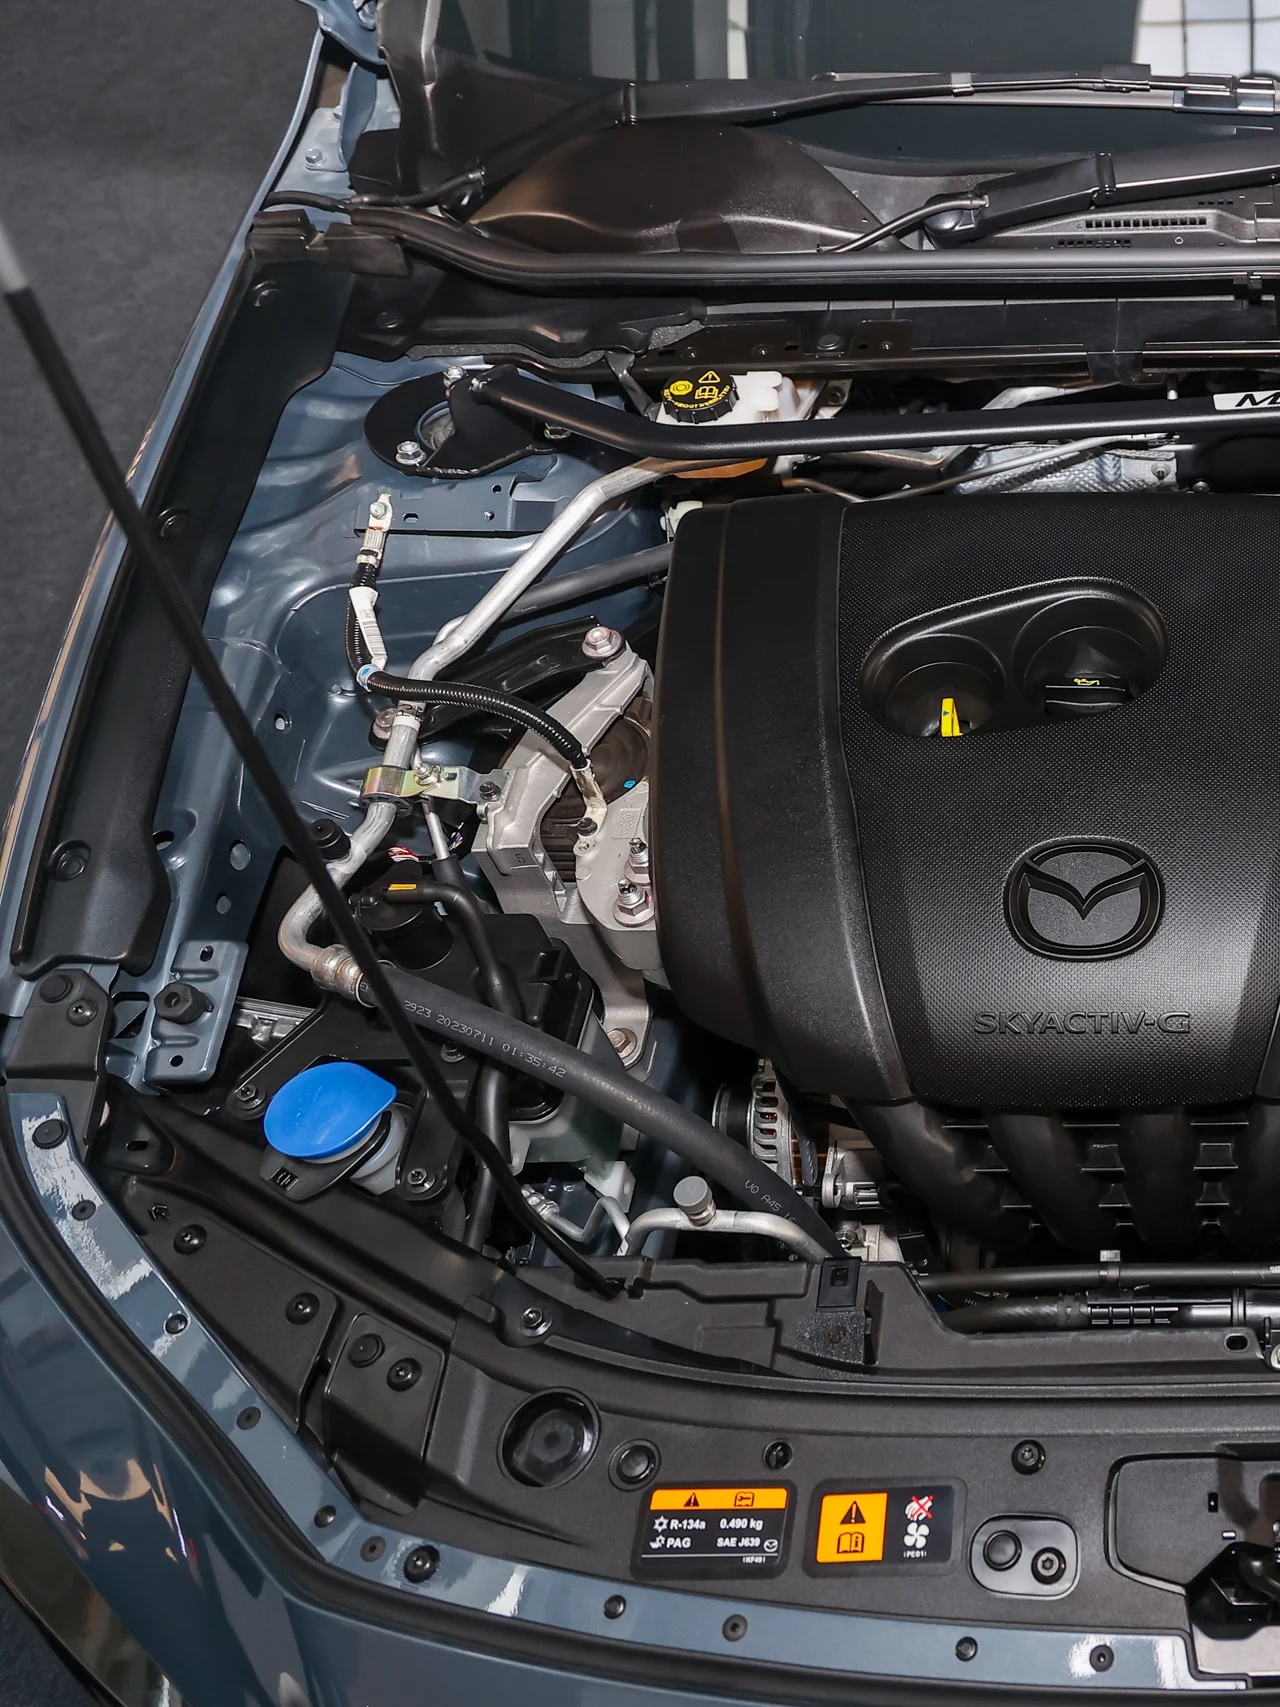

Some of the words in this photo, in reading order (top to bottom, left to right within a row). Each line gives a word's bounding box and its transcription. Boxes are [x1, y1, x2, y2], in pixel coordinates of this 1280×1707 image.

[974, 1011, 1191, 1035] SKYACTIV-G
[404, 1000, 432, 1018] 2923
[436, 1014, 494, 1046] 20230711
[502, 1043, 566, 1078] 01:35:42
[761, 1194, 782, 1212] A45
[669, 1518, 706, 1530] R-134a
[720, 1518, 748, 1529] 0.490
[749, 1518, 763, 1531] kg
[666, 1537, 691, 1548] PAG
[716, 1537, 737, 1547] SAE
[738, 1537, 760, 1547] J639
